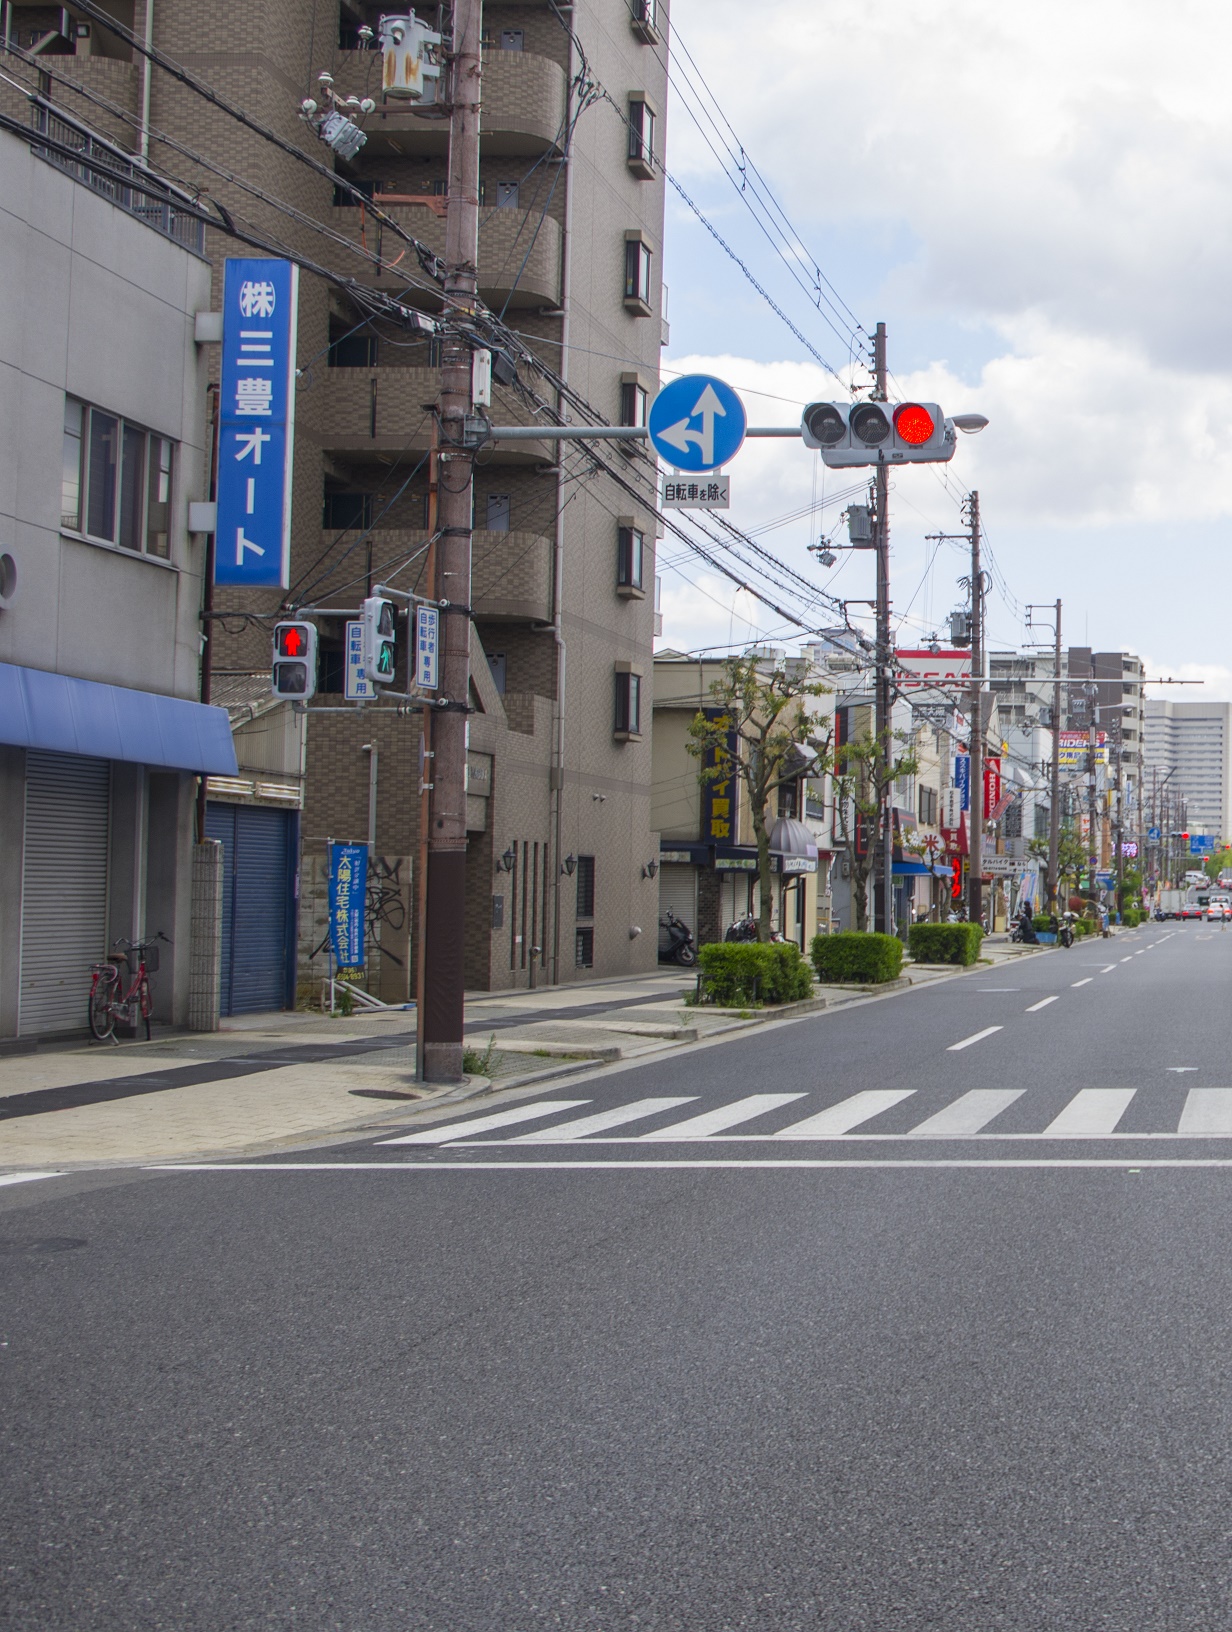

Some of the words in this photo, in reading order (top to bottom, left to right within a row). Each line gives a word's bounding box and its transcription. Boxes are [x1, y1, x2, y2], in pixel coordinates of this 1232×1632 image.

[665, 483, 727, 501] 自転車を除く
[350, 626, 362, 665] 自転車
[419, 612, 428, 652] 自転車
[428, 613, 437, 653] 歩行者
[423, 655, 431, 682] 専用
[897, 672, 973, 688] ISSAN
[710, 715, 733, 839] オトバイ買取
[989, 773, 997, 817] HOND
[336, 855, 351, 963] 太陽住宅株式会社
